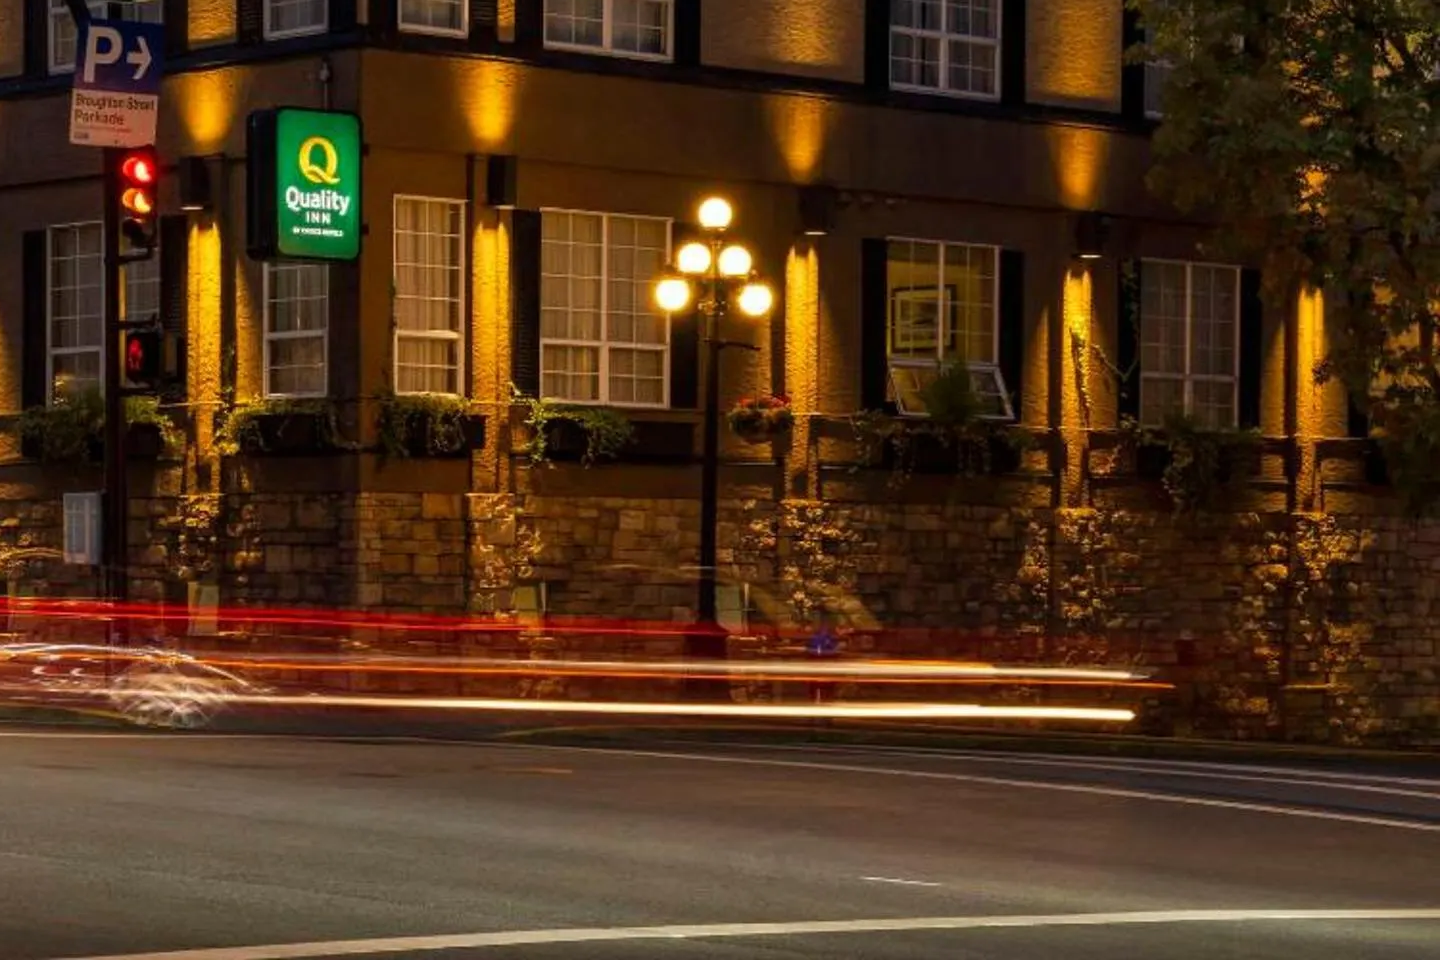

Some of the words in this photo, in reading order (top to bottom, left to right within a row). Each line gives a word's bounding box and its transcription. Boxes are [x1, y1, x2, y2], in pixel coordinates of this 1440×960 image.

[83, 26, 123, 83] P
[127, 95, 155, 111] Street
[74, 109, 125, 126] Parkade
[299, 136, 341, 184] Q
[285, 185, 351, 216] Quality
[306, 211, 331, 224] INN
